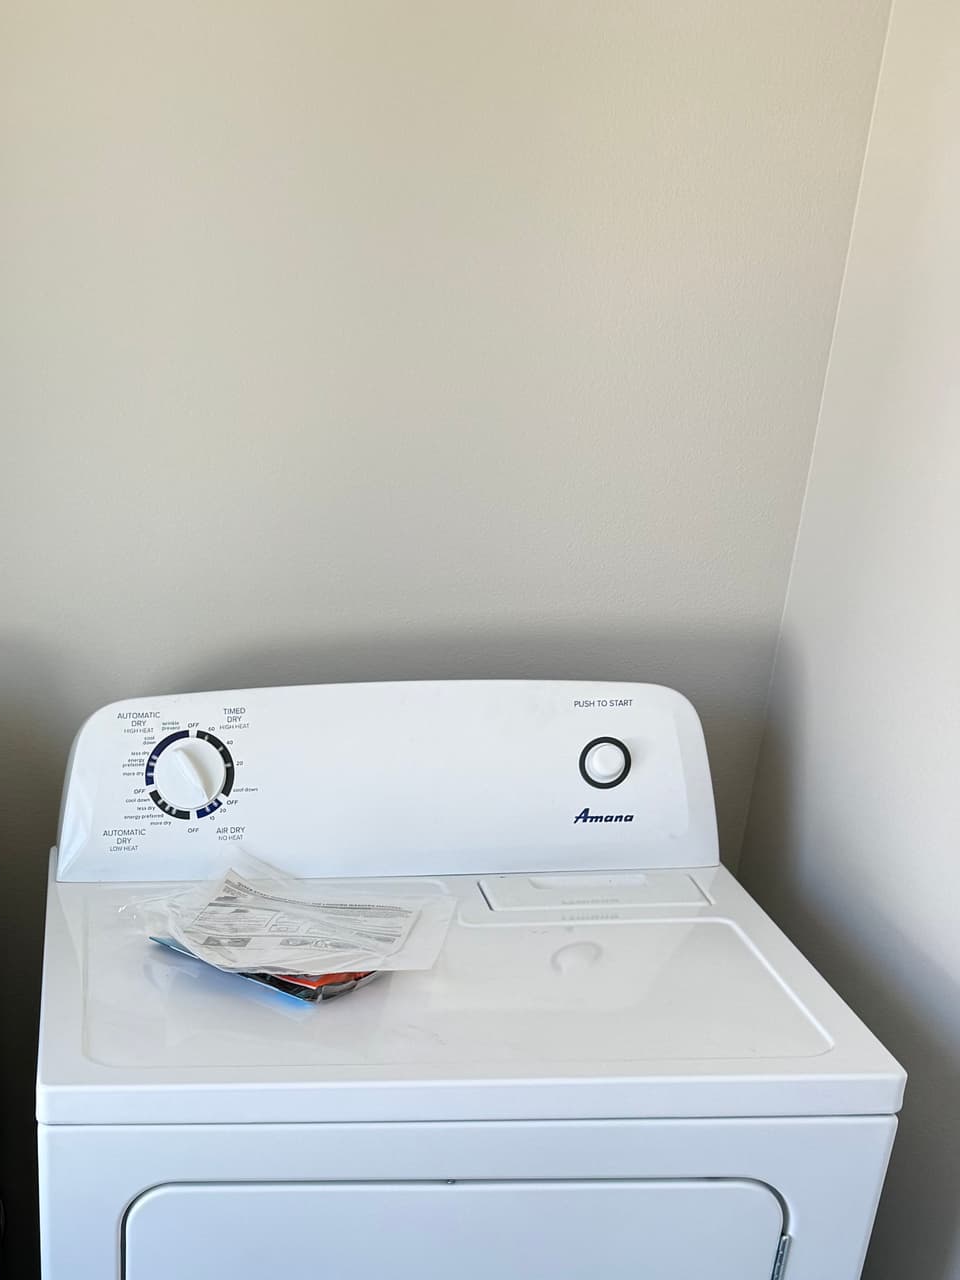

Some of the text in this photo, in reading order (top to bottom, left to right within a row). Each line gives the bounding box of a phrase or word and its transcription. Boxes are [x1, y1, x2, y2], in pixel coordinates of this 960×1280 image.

[609, 699, 633, 707] START
[224, 707, 246, 715] TIMED
[573, 807, 634, 824] Amana
[103, 829, 146, 837] AUTOMATIC
